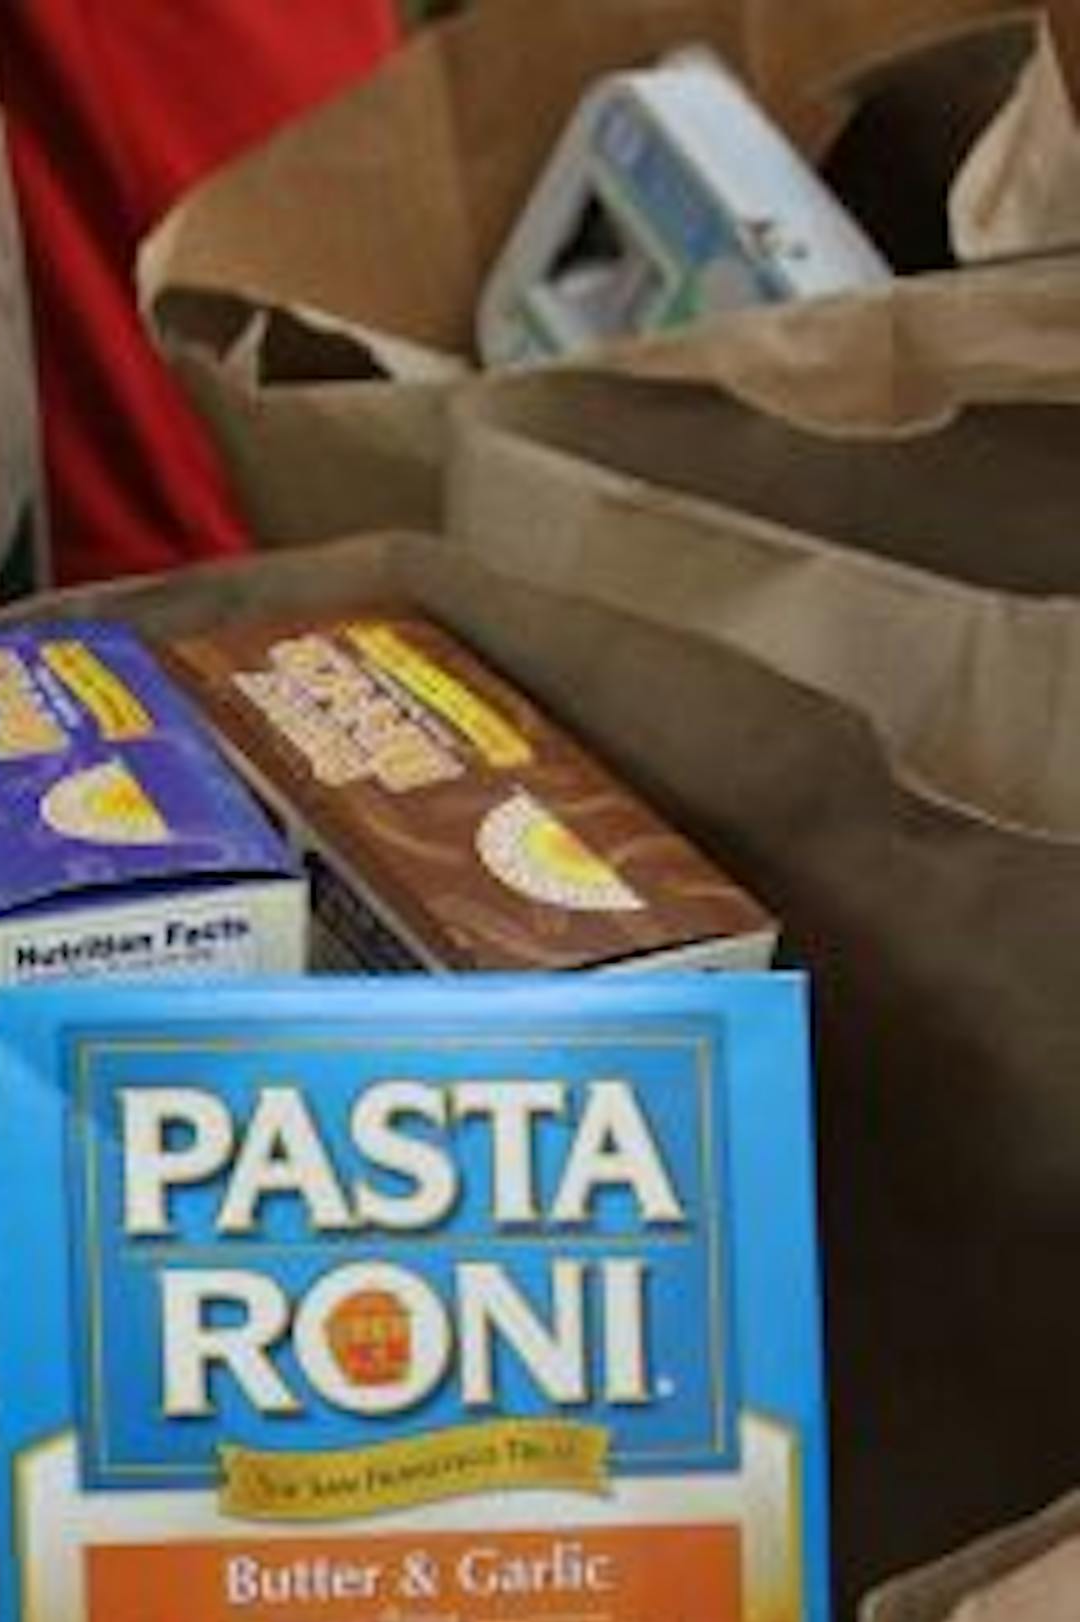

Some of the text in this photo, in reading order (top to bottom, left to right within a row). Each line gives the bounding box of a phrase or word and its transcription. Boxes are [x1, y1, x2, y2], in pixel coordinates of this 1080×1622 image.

[15, 933, 153, 966] Nutrition
[165, 917, 250, 947] Facts
[119, 1080, 683, 1234] PASTA
[225, 1541, 615, 1606] Butter & Garlic
